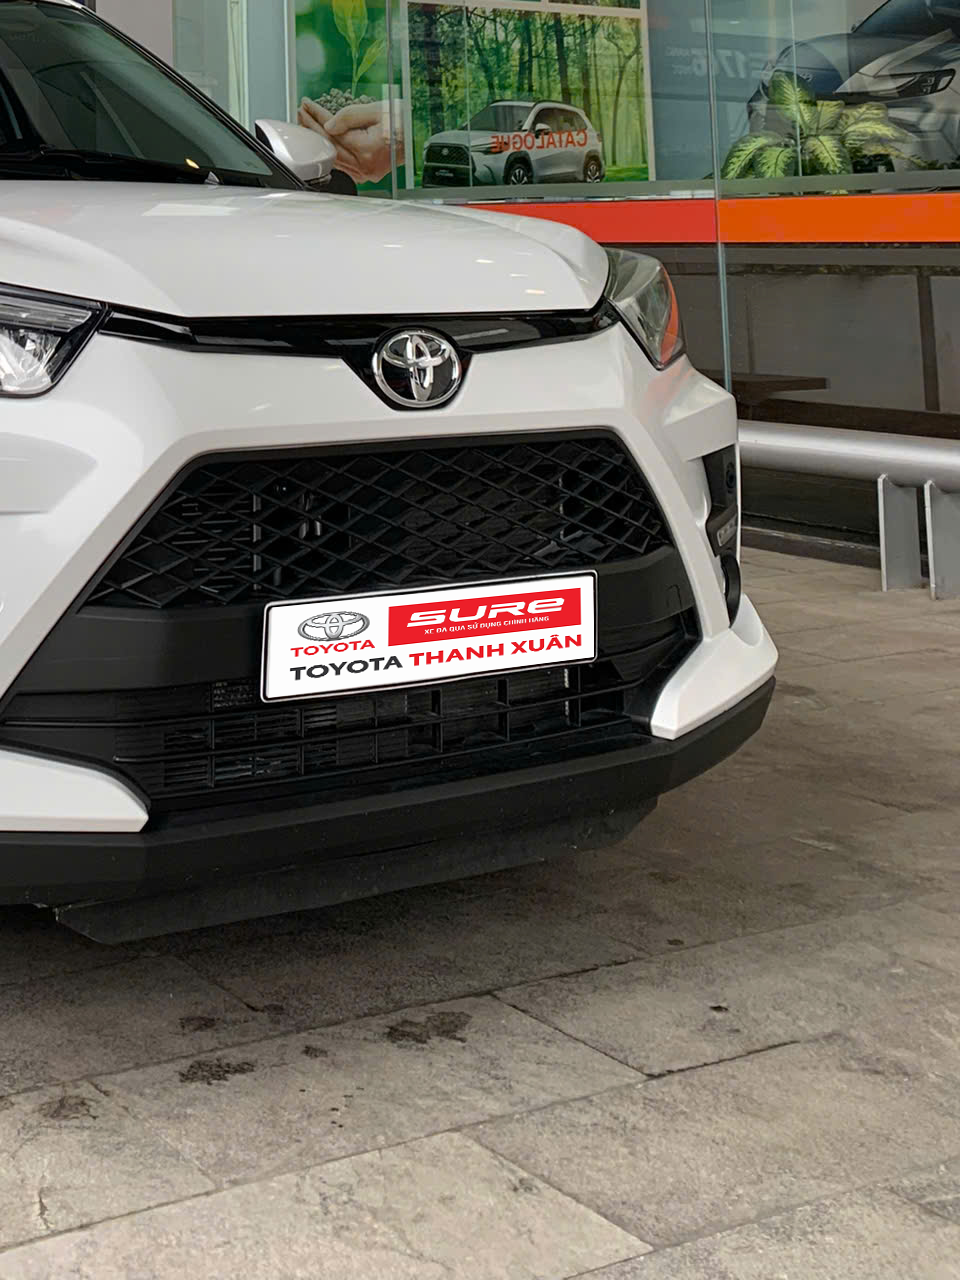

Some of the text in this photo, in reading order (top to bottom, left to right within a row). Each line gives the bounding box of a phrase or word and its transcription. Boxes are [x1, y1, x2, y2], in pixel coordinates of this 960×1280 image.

[290, 639, 376, 658] TOYOTA
[290, 634, 582, 681] TOYOTA THANH XUÂN
